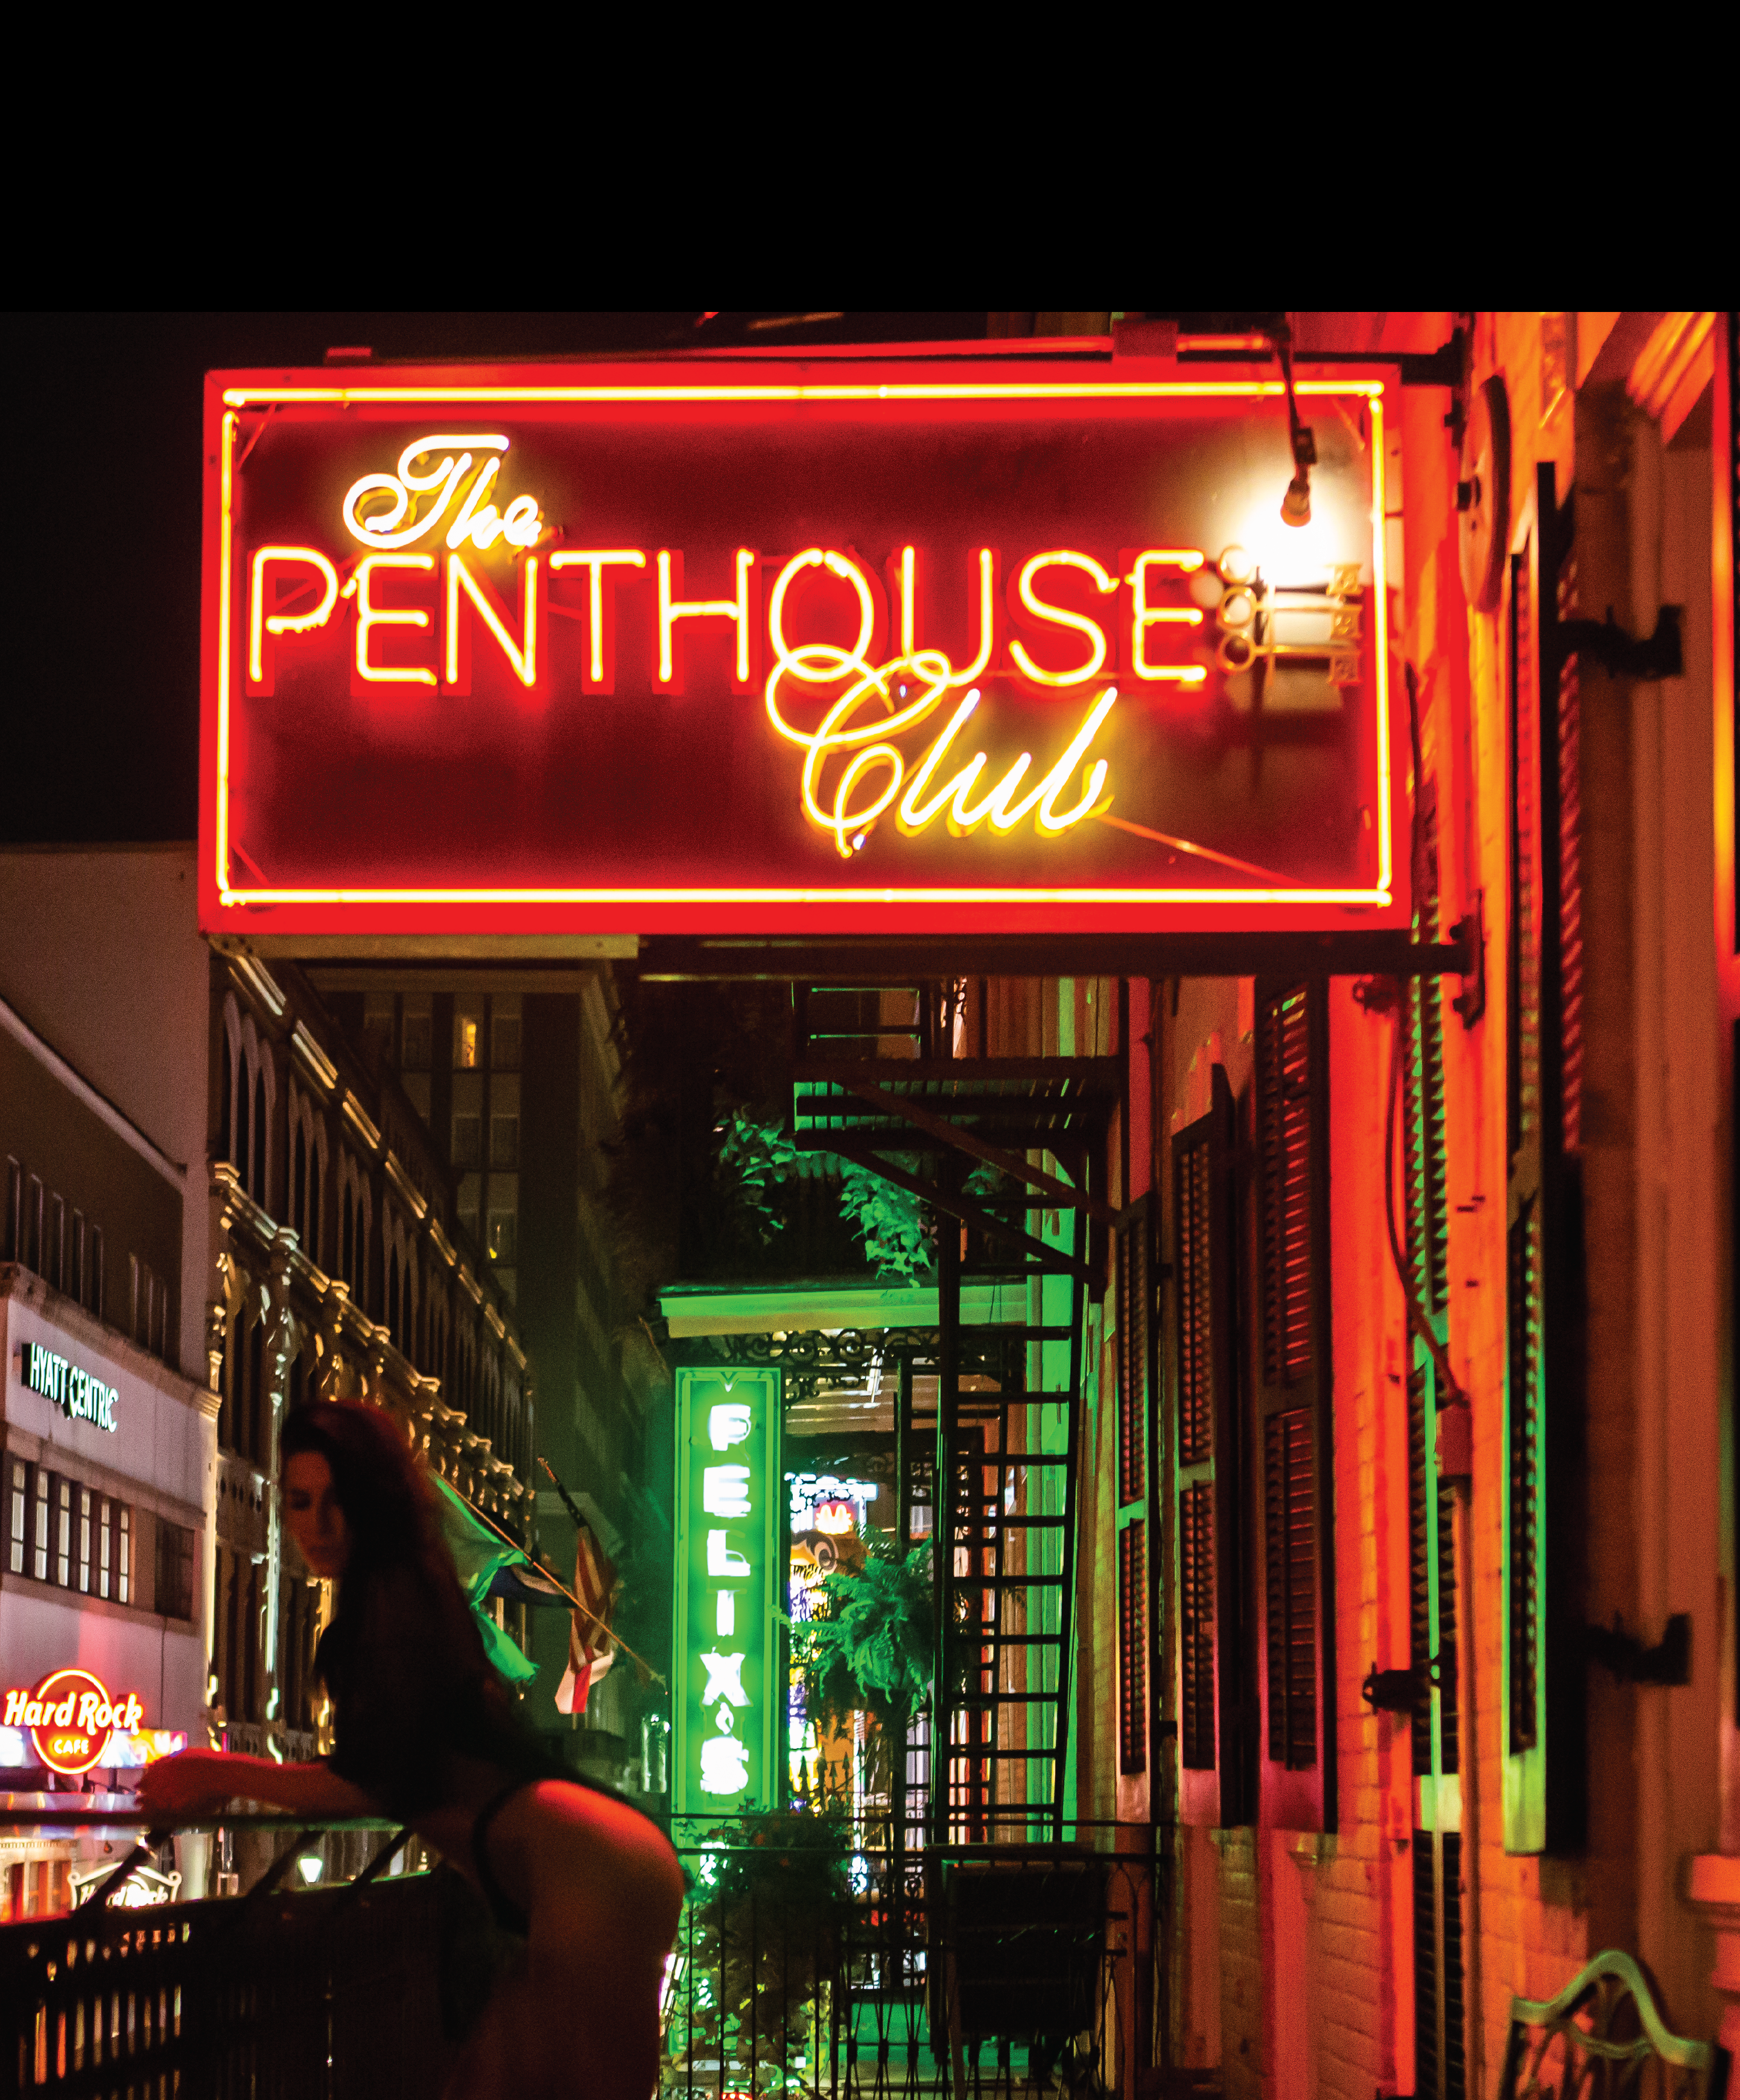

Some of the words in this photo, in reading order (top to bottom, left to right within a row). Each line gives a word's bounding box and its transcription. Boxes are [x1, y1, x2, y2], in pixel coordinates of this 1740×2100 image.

[343, 434, 542, 550] The
[248, 544, 1207, 688] PENTHOUSE
[764, 643, 1118, 858] Club
[30, 1341, 69, 1405] HYATT
[69, 1365, 119, 1433] CENTRIC
[4, 1689, 77, 1727] Hard
[77, 1691, 144, 1736] Rock
[52, 1738, 90, 1755] CAFE
